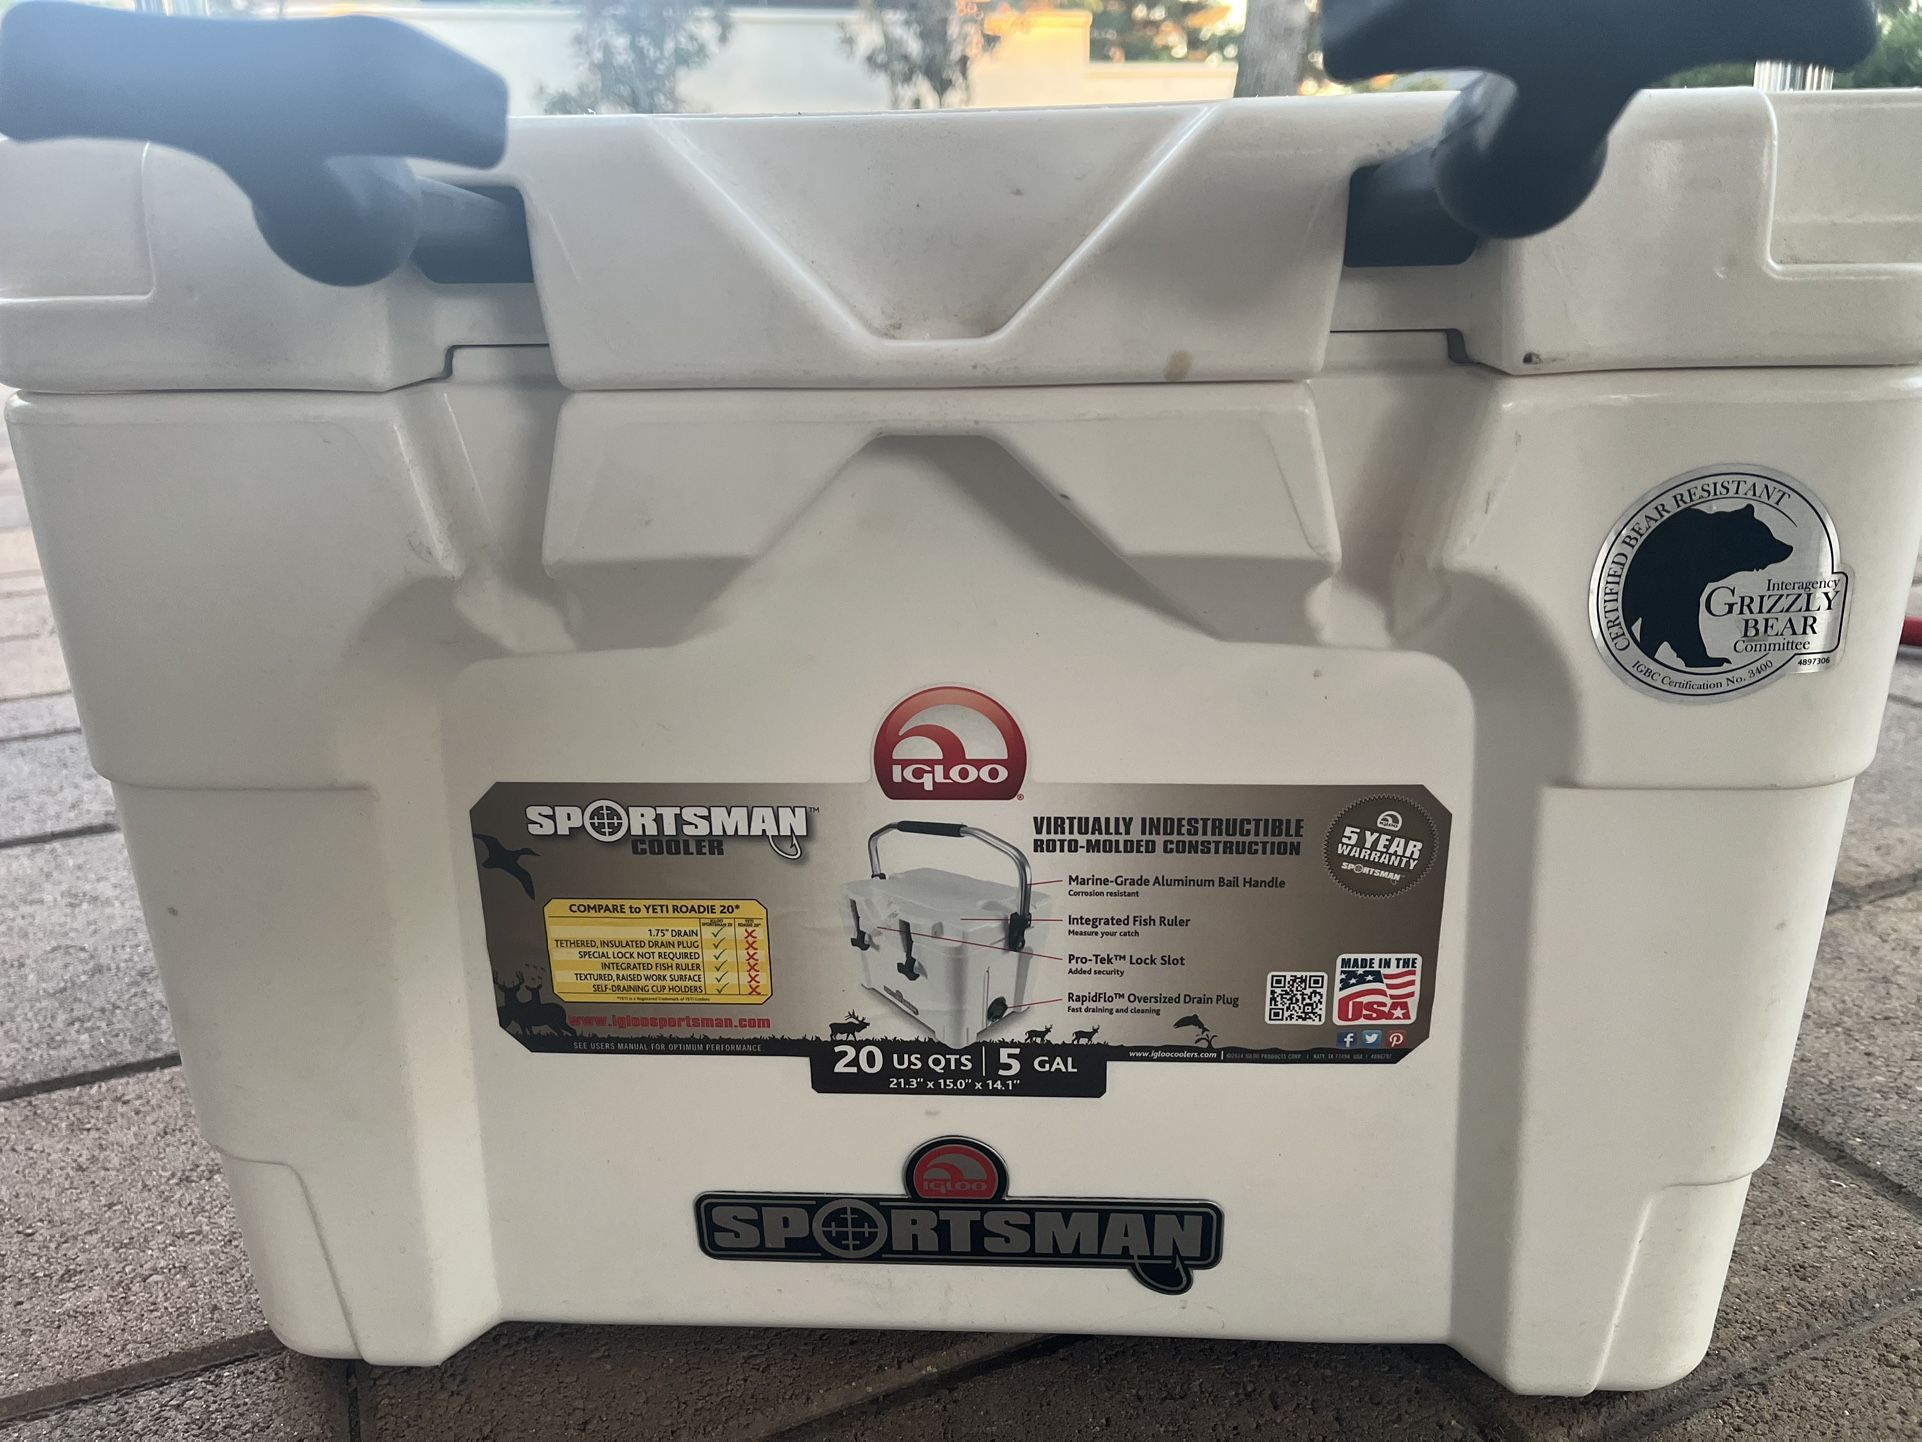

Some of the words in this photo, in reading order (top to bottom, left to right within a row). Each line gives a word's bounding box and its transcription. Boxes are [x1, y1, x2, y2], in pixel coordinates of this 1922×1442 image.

[1603, 552, 1630, 652] CERTIFIED
[1621, 503, 1672, 550] BEAR
[1672, 479, 1791, 509] RESISTANT
[1766, 578, 1840, 592] Interagency
[1704, 586, 1840, 617] GRIZZLY
[1741, 615, 1818, 638] BEAR
[1733, 638, 1811, 653] Committee
[1797, 657, 1831, 666] 4897306
[1631, 659, 1660, 682] IGBC
[1660, 675, 1723, 690] Certification
[1725, 674, 1747, 687] No.
[1747, 659, 1773, 679] 3400
[892, 764, 1009, 791] IGLOO
[1033, 816, 1134, 836] VIRTUALLY
[1140, 817, 1304, 838] INDESTRUCTIBLE
[631, 838, 725, 856] COOLER
[1033, 838, 1156, 854] ROTO-MOLDED
[1162, 840, 1301, 856] CONSTRUCTION
[1341, 826, 1360, 845] 5
[1364, 830, 1423, 859] YEAR
[1337, 843, 1418, 870] WARRANTY
[1341, 862, 1401, 880] SPORTSMAN
[1068, 874, 1150, 887] Marine-Grade
[1152, 875, 1215, 888] Aluminum
[1218, 876, 1240, 888] Bail
[1243, 877, 1286, 889] Handle
[1068, 889, 1104, 897] Corrosion
[568, 903, 626, 914] COMPARE
[629, 904, 641, 914] to
[643, 904, 669, 914] YETI
[672, 904, 717, 914] ROADIE
[1068, 915, 1130, 928] Integrated
[1132, 915, 1156, 926] Fish
[1159, 916, 1191, 927] Ruler
[648, 929, 669, 937] 1.75"
[671, 929, 698, 938] DRAIN
[554, 940, 599, 949] TETHERED,
[600, 940, 646, 949] INSULATED
[648, 941, 676, 949] DRAIN
[677, 941, 699, 949] PLUG
[578, 951, 610, 959] SPECIAL
[612, 951, 635, 959] LOCK
[658, 952, 700, 961] REQUIRED
[1129, 955, 1157, 965] Lock
[1160, 955, 1186, 966] Slot
[1340, 957, 1375, 969] MADE
[1378, 957, 1392, 969] IN
[1395, 957, 1417, 969] THE
[601, 962, 653, 971] INTEGRATED
[655, 963, 673, 971] FISH
[675, 963, 701, 971] RULER
[1094, 968, 1125, 977] security
[574, 973, 615, 982] TEXTURED,
[616, 973, 642, 981] RAISED
[643, 973, 667, 981] WORK
[669, 974, 702, 982] SURFACE
[592, 984, 649, 993] SELF-DRAINING
[651, 985, 667, 993] CUP
[668, 985, 703, 994] HOLDERS
[1128, 993, 1181, 1004] Oversized
[1184, 994, 1213, 1005] Drain
[1215, 995, 1239, 1008] Plug
[1084, 1006, 1113, 1015] draining
[1130, 1007, 1160, 1015] cleaning
[1338, 998, 1411, 1022] USA
[568, 1015, 770, 1029] www.igloosportsman.com
[617, 1042, 648, 1050] MANUAL
[668, 1043, 703, 1051] OPTIMUM
[706, 1043, 761, 1051] PERFORMANCE
[833, 1045, 883, 1073] 20
[892, 1054, 922, 1070] US
[928, 1054, 972, 1072] QTS
[998, 1047, 1021, 1076] 5
[1033, 1056, 1077, 1072] GAL
[1129, 1050, 1217, 1059] www.igloocoolers.com
[889, 1078, 924, 1089] 21.3"
[938, 1078, 971, 1090] 15.0"
[975, 1082, 982, 1090] x
[986, 1079, 1020, 1090] 14.1"
[923, 1181, 987, 1193] IGLOO
[711, 1199, 1203, 1258] SPORTSMAN
